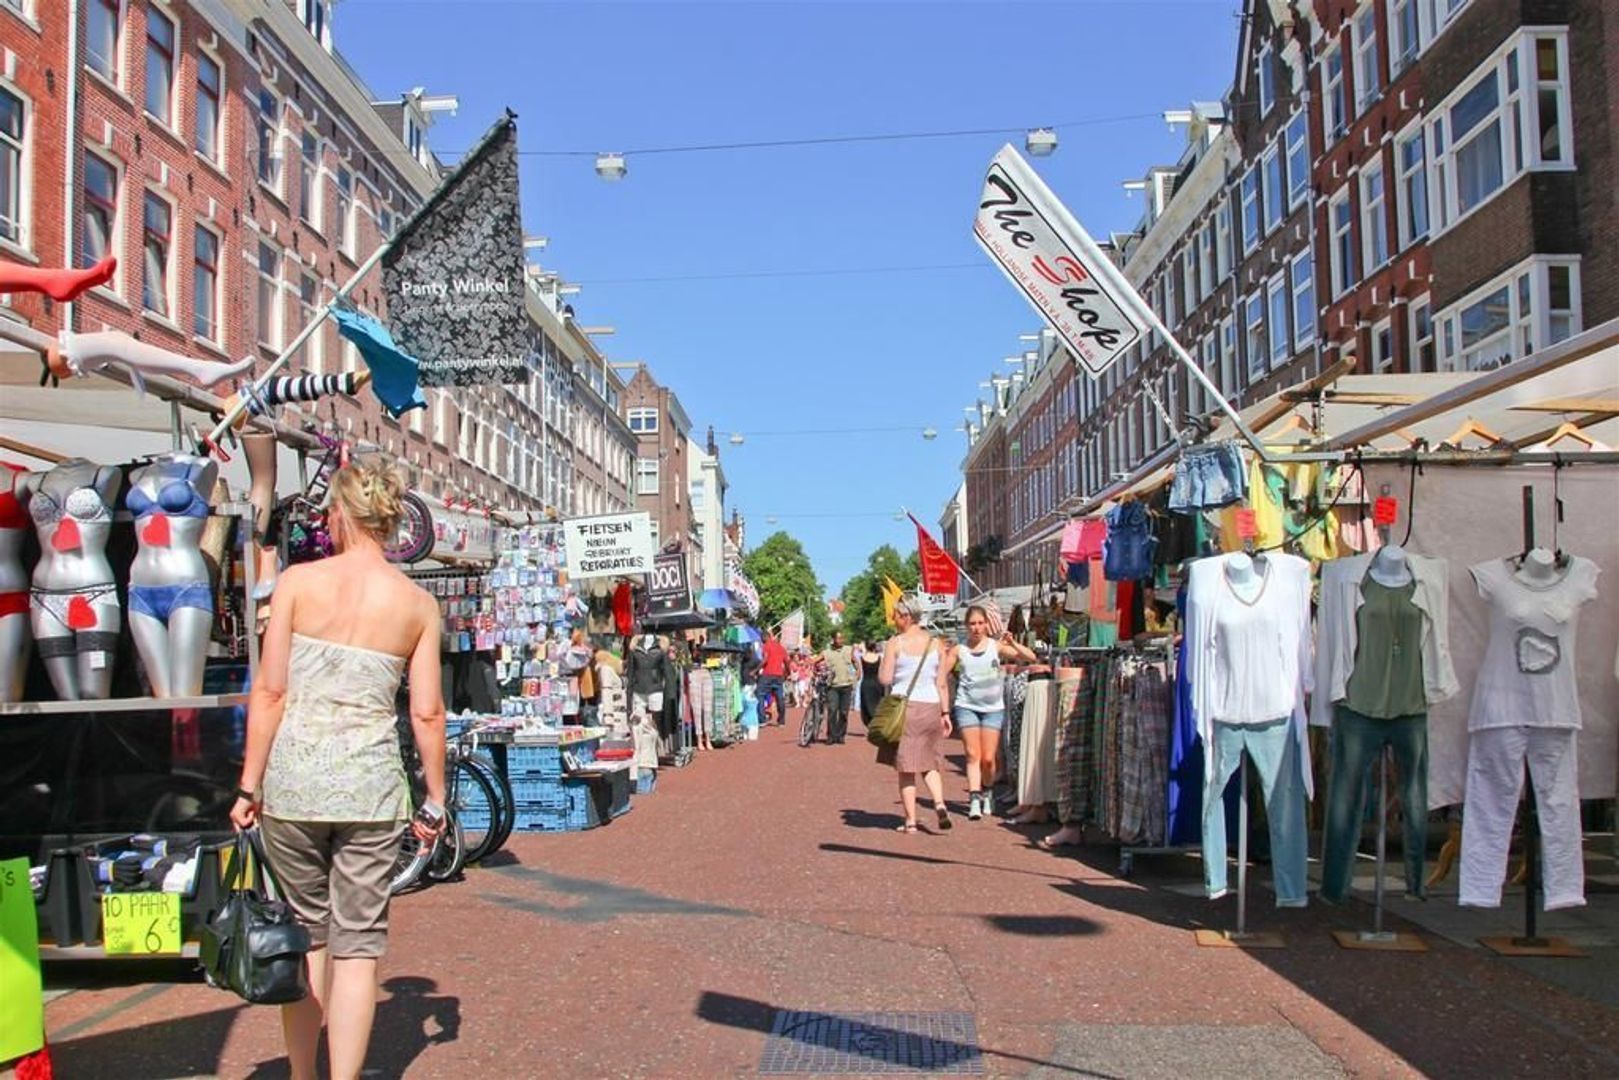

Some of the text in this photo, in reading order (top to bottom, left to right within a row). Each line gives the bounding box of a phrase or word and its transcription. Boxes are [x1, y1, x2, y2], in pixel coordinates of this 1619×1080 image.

[981, 174, 1121, 350] The Shop
[401, 278, 509, 298] Panty Winkel
[577, 521, 632, 535] FIETSEN
[103, 896, 123, 917] 10
[145, 918, 162, 953] 6
